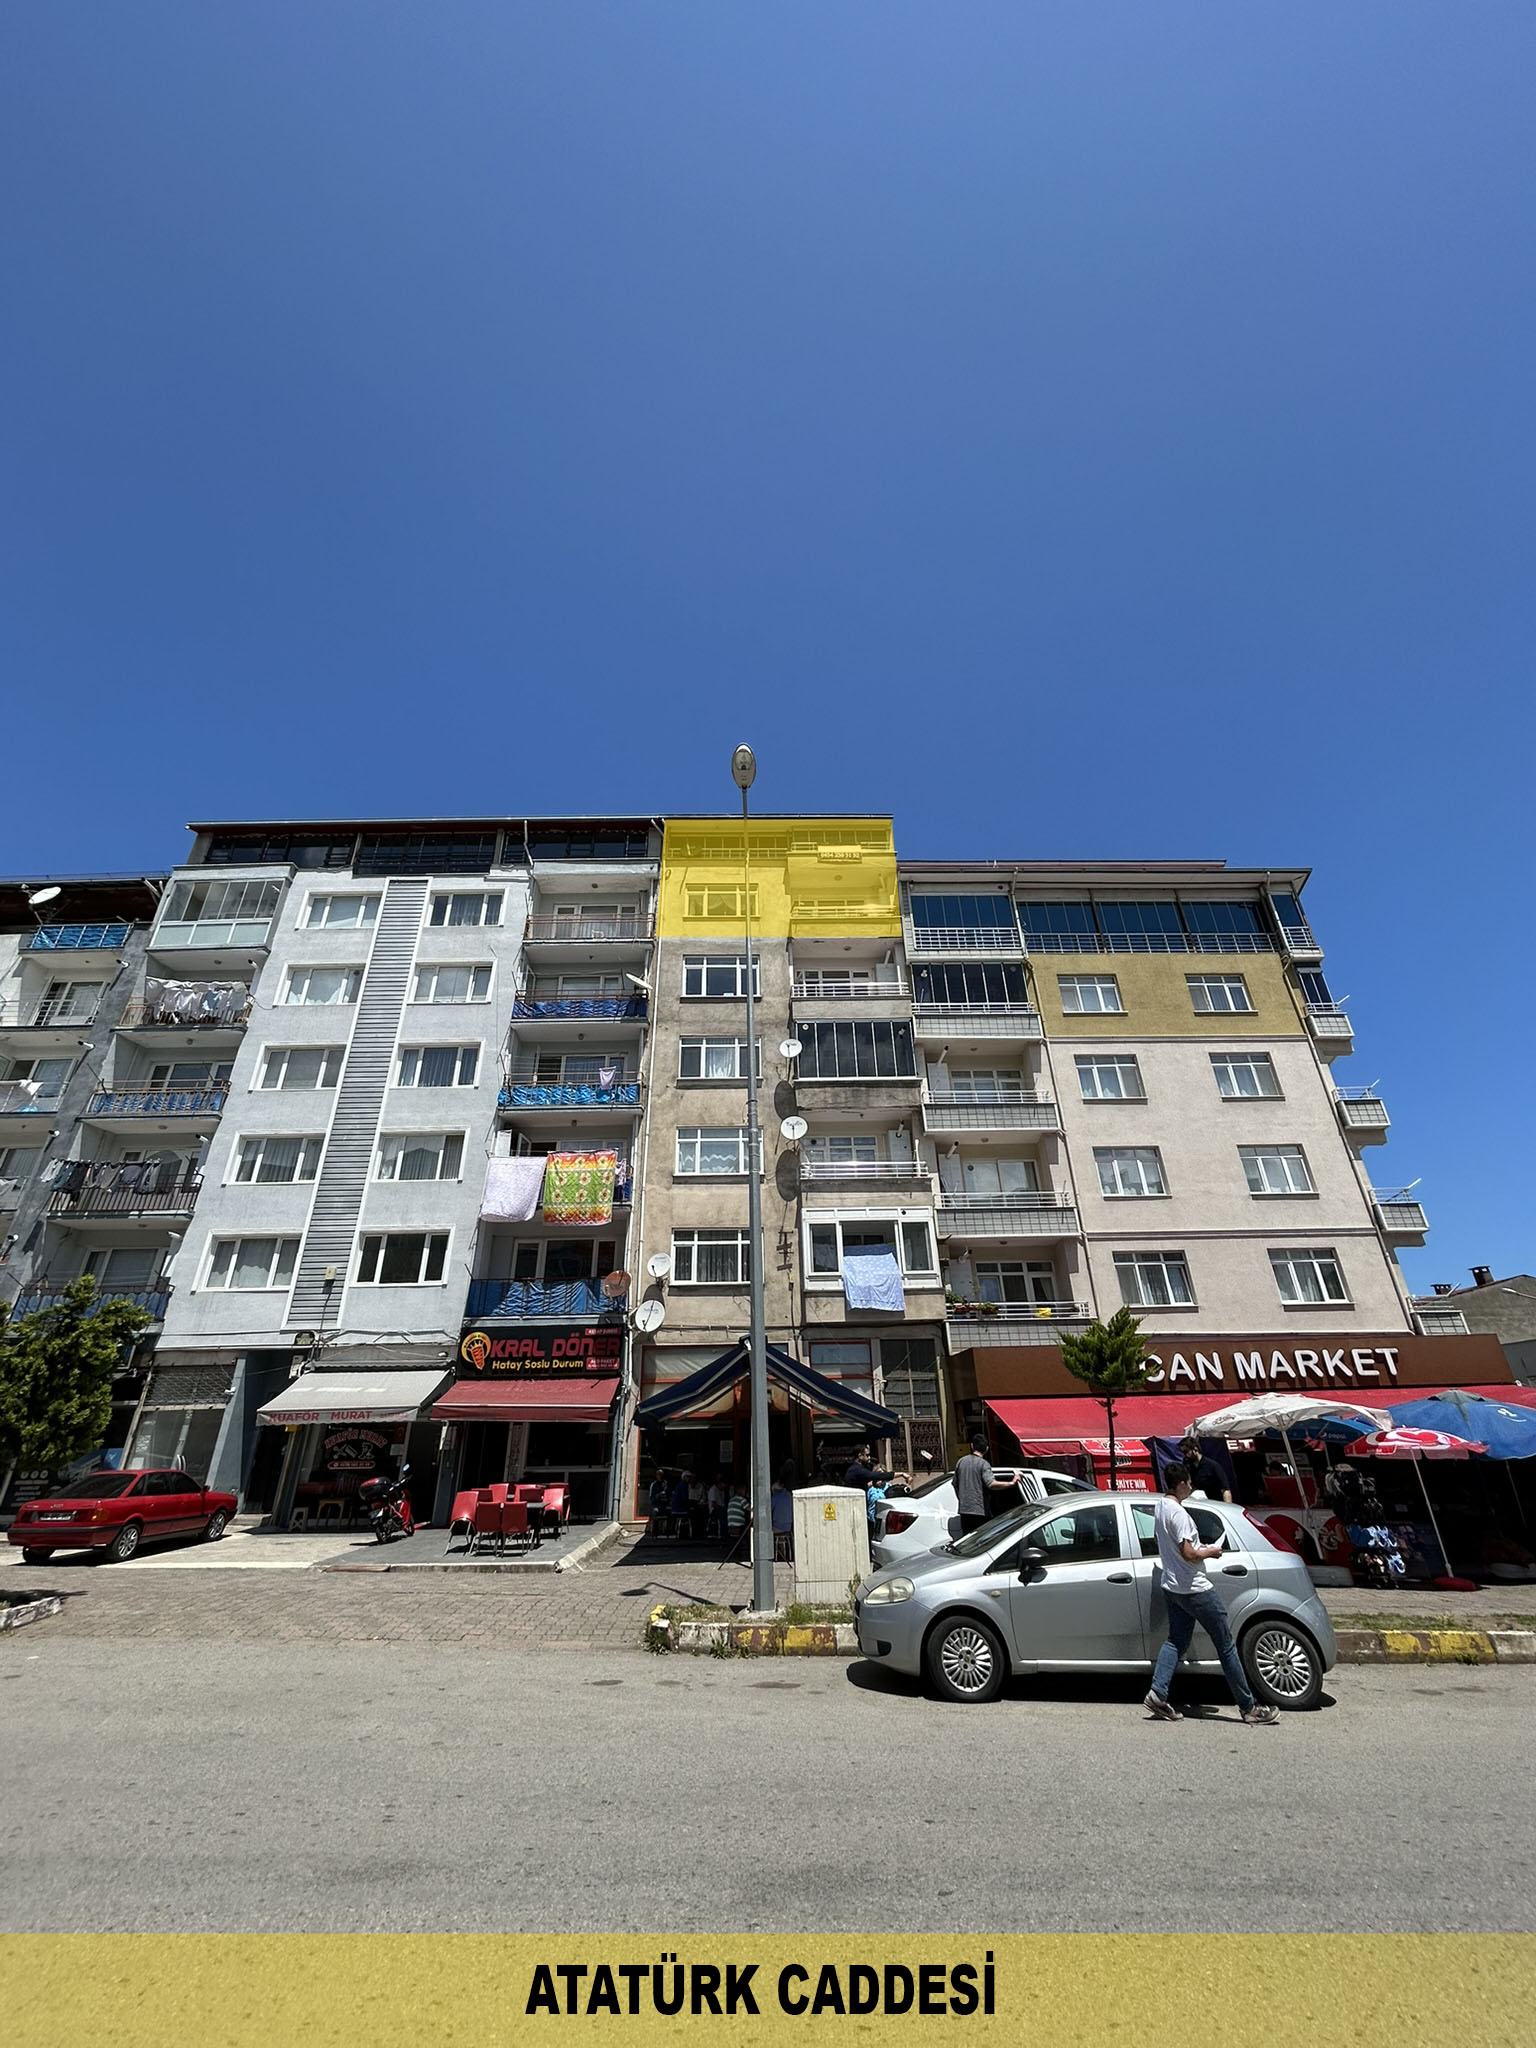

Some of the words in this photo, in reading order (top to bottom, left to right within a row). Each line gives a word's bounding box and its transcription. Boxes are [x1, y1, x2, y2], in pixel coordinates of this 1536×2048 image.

[490, 1338, 545, 1358] KRAL
[551, 1333, 620, 1357] DÖNER
[492, 1361, 522, 1371] Hatay
[524, 1360, 550, 1369] Soslu
[552, 1358, 584, 1368] Durum
[1138, 1351, 1224, 1382] CAN
[1233, 1347, 1399, 1380] MARKET
[330, 1410, 372, 1421] MURAT
[1106, 1478, 1147, 1489] TRKİYE'NİN
